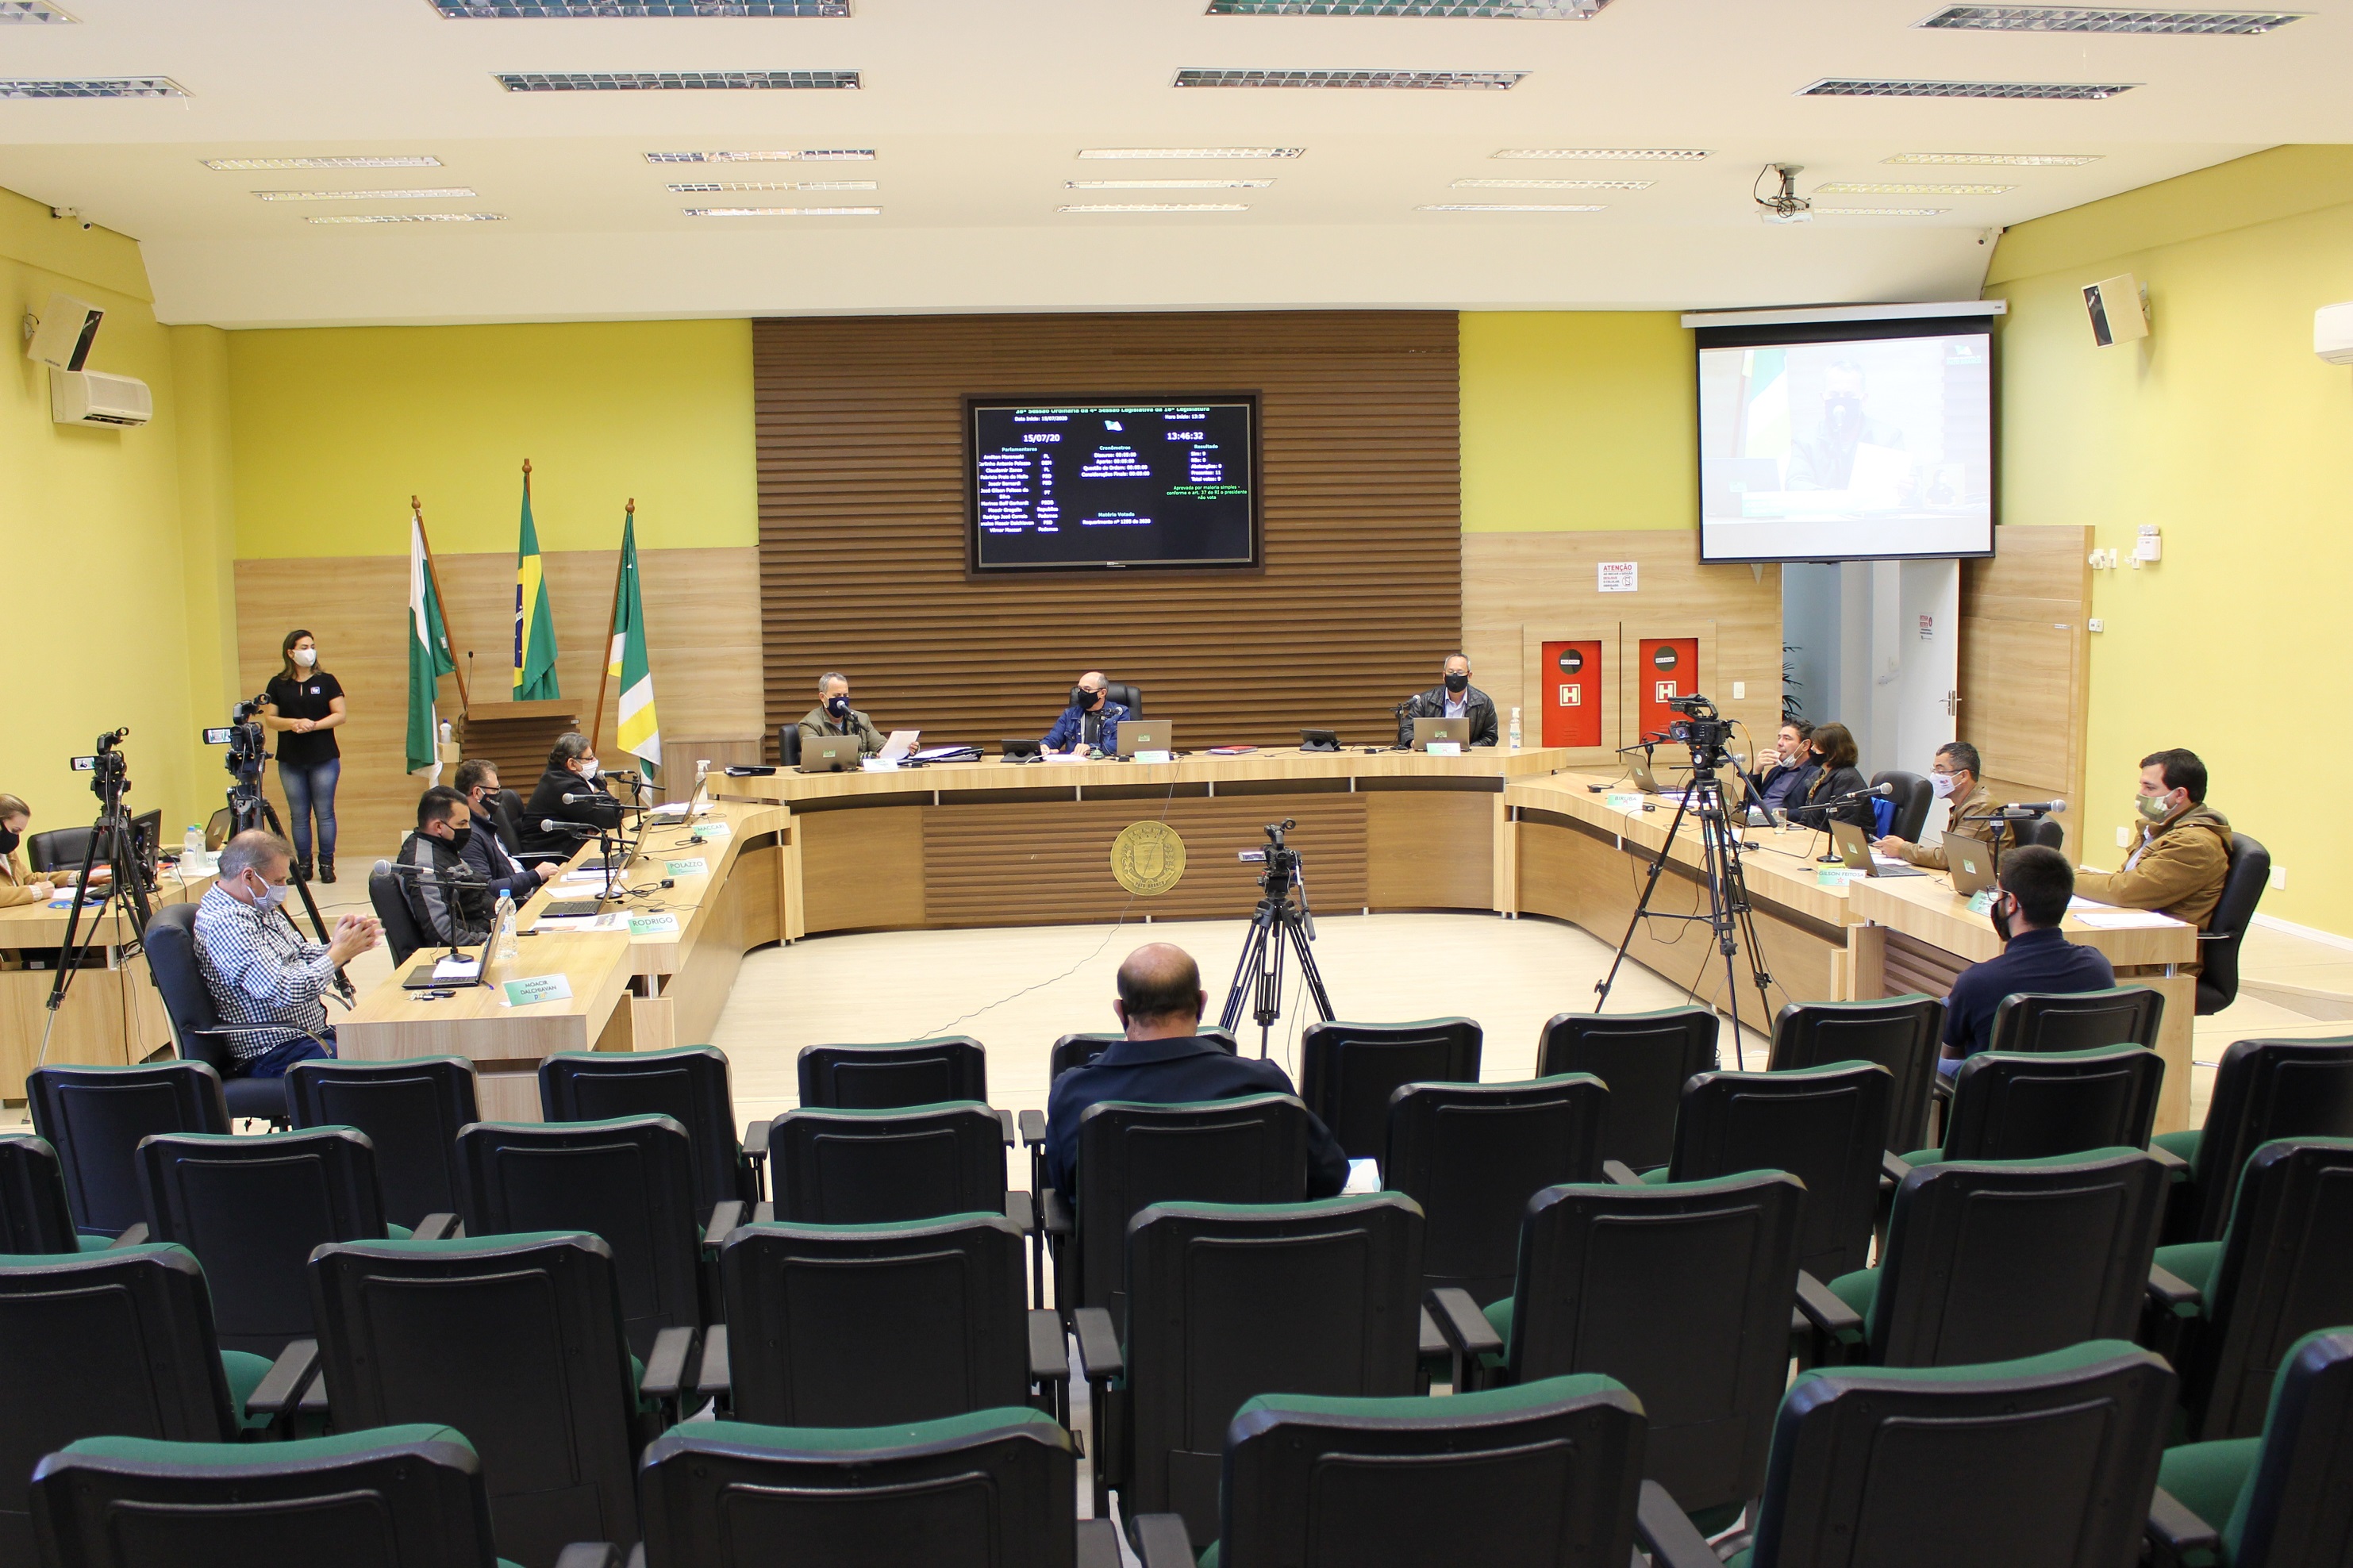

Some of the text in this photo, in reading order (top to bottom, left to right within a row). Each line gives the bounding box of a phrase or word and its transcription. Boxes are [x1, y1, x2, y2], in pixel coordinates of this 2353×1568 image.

[1023, 433, 1060, 444] 15/07/20
[1563, 687, 1578, 702] H
[632, 917, 673, 927] RODRIGO
[520, 985, 557, 995] DALCHIAVAN
